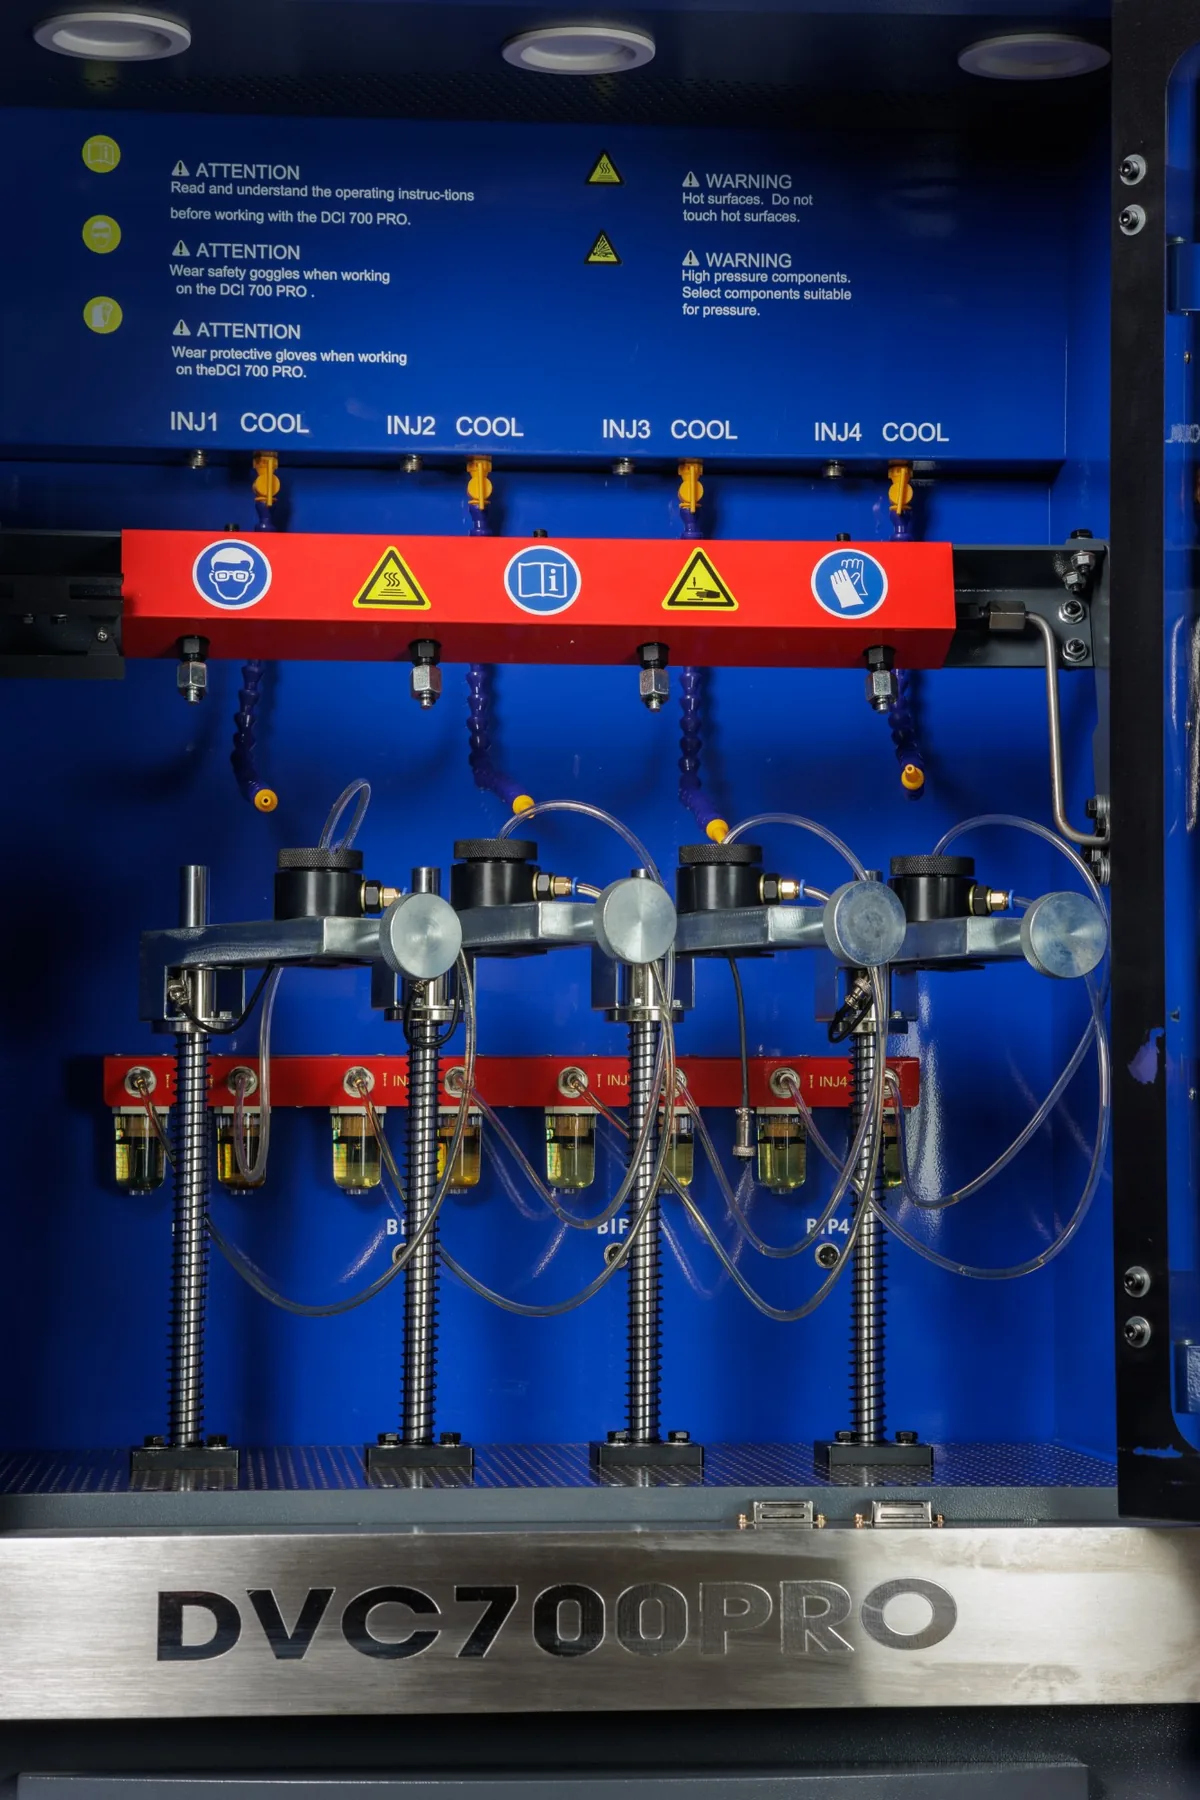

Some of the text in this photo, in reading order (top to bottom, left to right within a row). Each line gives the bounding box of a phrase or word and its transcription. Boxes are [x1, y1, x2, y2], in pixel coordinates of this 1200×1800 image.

[196, 162, 300, 181] ATTENTION
[705, 173, 793, 190] WARNING
[170, 181, 475, 202] Read and understand the operating instruc-tions
[682, 192, 813, 206] Hot surfaces. Do not
[170, 207, 412, 226] before working with the DCI 700 PRO.
[682, 208, 801, 223] touch hot surfaces.
[196, 243, 301, 261] ATTENTION
[705, 252, 793, 269] WARNING
[169, 264, 391, 285] Wear safety goggles when working
[682, 269, 852, 286] High pressure components.
[175, 284, 193, 295] on
[196, 283, 216, 296] the
[220, 283, 245, 297] DCI
[248, 284, 272, 297] 700
[682, 285, 853, 302] Select components suitable
[682, 303, 761, 319] for pressure.
[196, 322, 302, 340] ATTENTION
[171, 346, 408, 367] Wear protective gloves when working
[175, 365, 193, 376] on
[244, 364, 269, 378] 700
[272, 365, 308, 379] PRO.
[170, 411, 218, 432] INJ1
[239, 412, 311, 434] COOL
[386, 414, 437, 436] INJ2
[455, 416, 525, 438] COOL
[602, 418, 652, 440] INJ3
[670, 418, 739, 441] COOL
[814, 421, 863, 443] INJ4
[881, 422, 951, 443] COOL
[607, 1074, 631, 1086] INJ
[819, 1076, 848, 1087] INJ4
[157, 1576, 958, 1661] DVC700PRO
